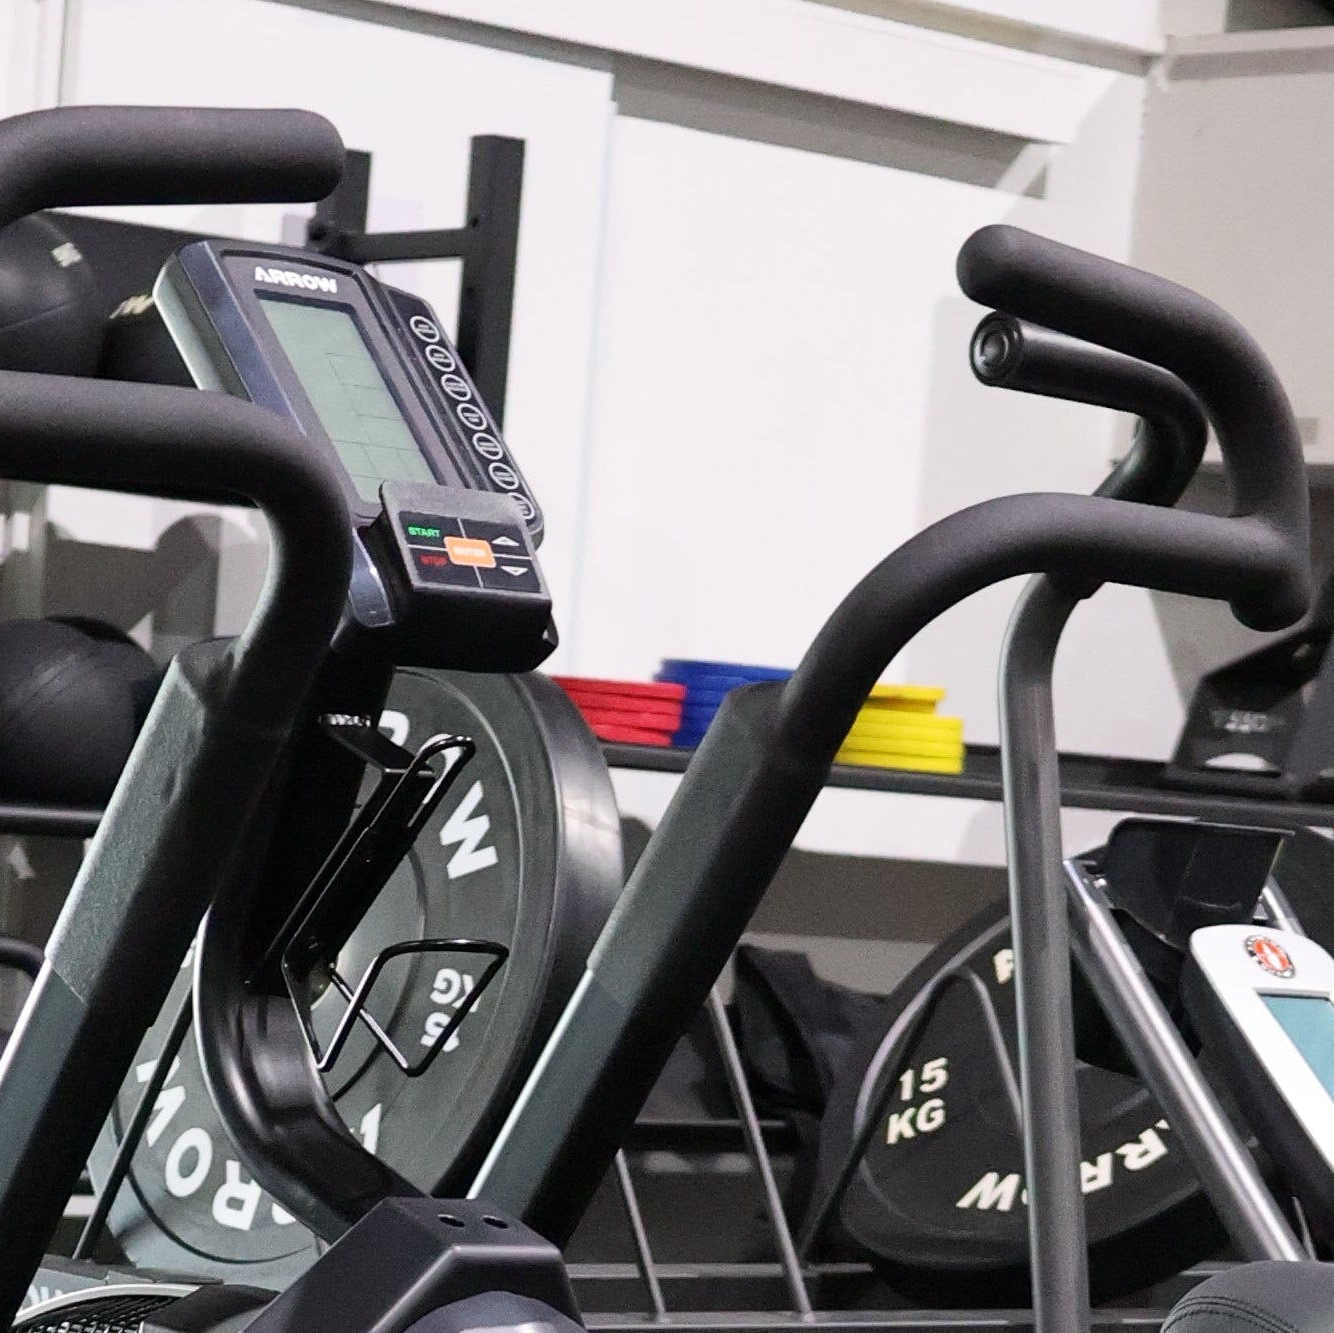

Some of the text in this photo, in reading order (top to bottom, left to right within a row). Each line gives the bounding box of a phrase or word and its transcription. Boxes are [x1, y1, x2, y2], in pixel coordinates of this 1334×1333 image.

[254, 265, 338, 293] ARROW
[407, 526, 441, 538] START
[898, 1057, 948, 1101] 15
[887, 1098, 946, 1145] KG
